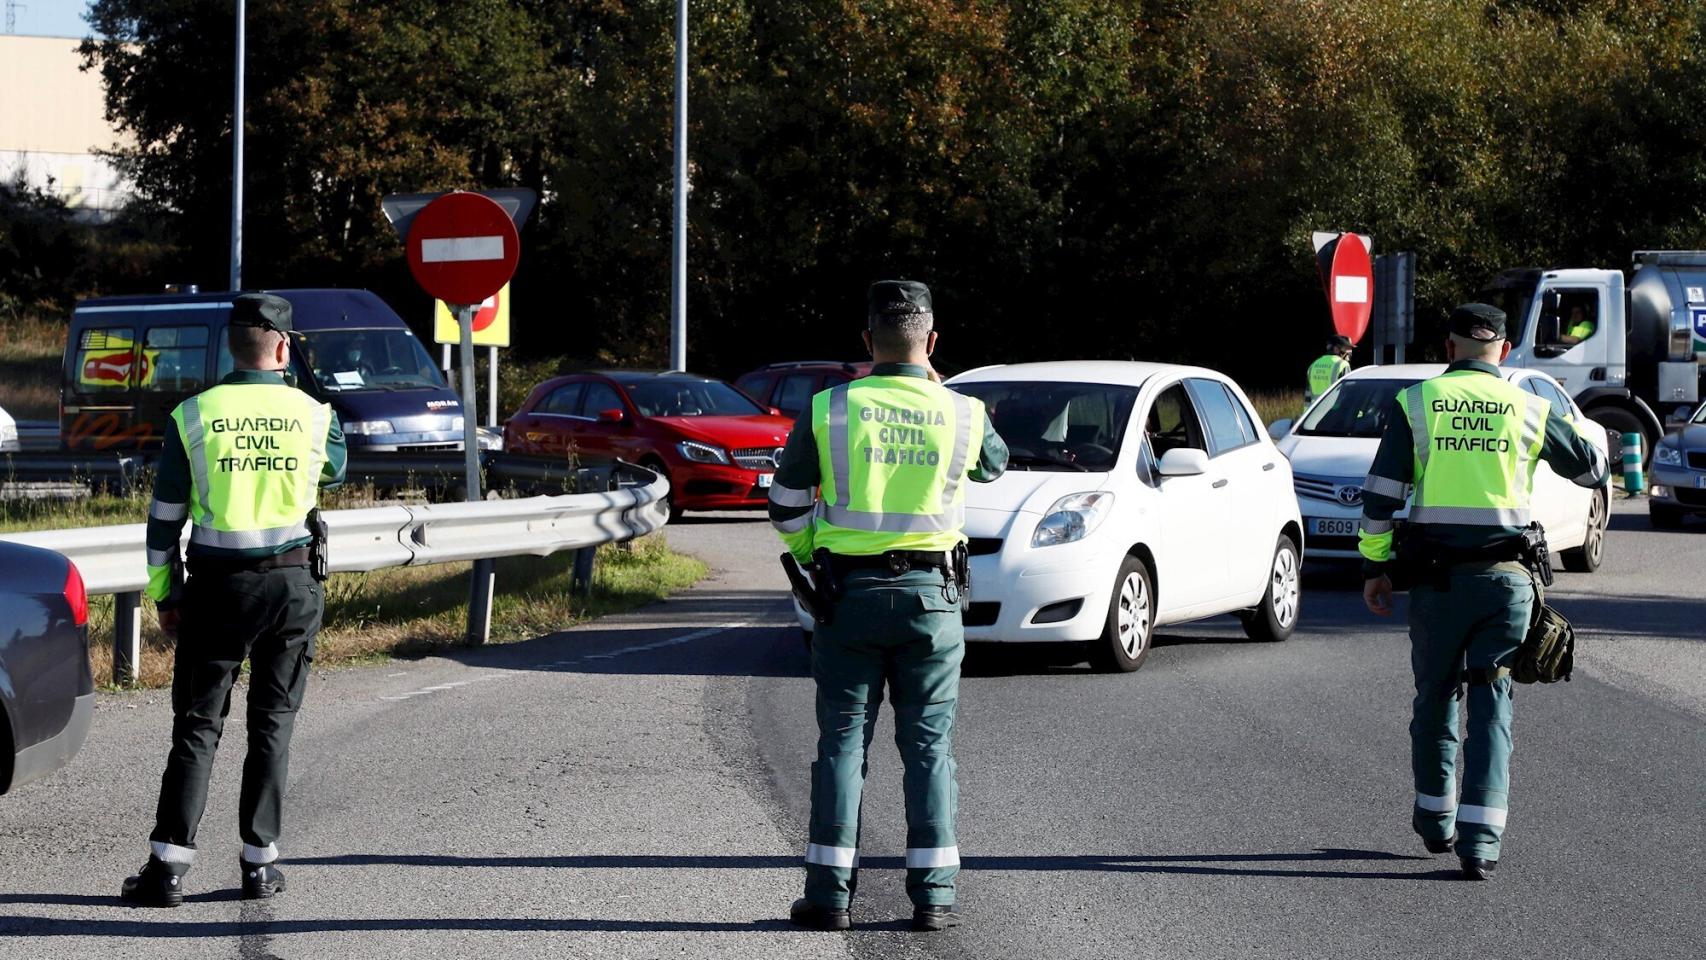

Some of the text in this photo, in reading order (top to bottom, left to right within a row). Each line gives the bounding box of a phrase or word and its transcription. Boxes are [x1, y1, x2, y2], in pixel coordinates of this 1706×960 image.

[860, 406, 945, 426] GUARDIA
[1432, 399, 1516, 417] GUARDIA
[211, 417, 303, 433] GUARDIA
[1452, 416, 1493, 431] CIVIL
[235, 435, 280, 450] CIVIL
[879, 428, 926, 445] CIVIL
[1434, 434, 1509, 453] TRÁFICO
[217, 453, 298, 473] TRÁFICO
[1318, 520, 1353, 534] 8609
